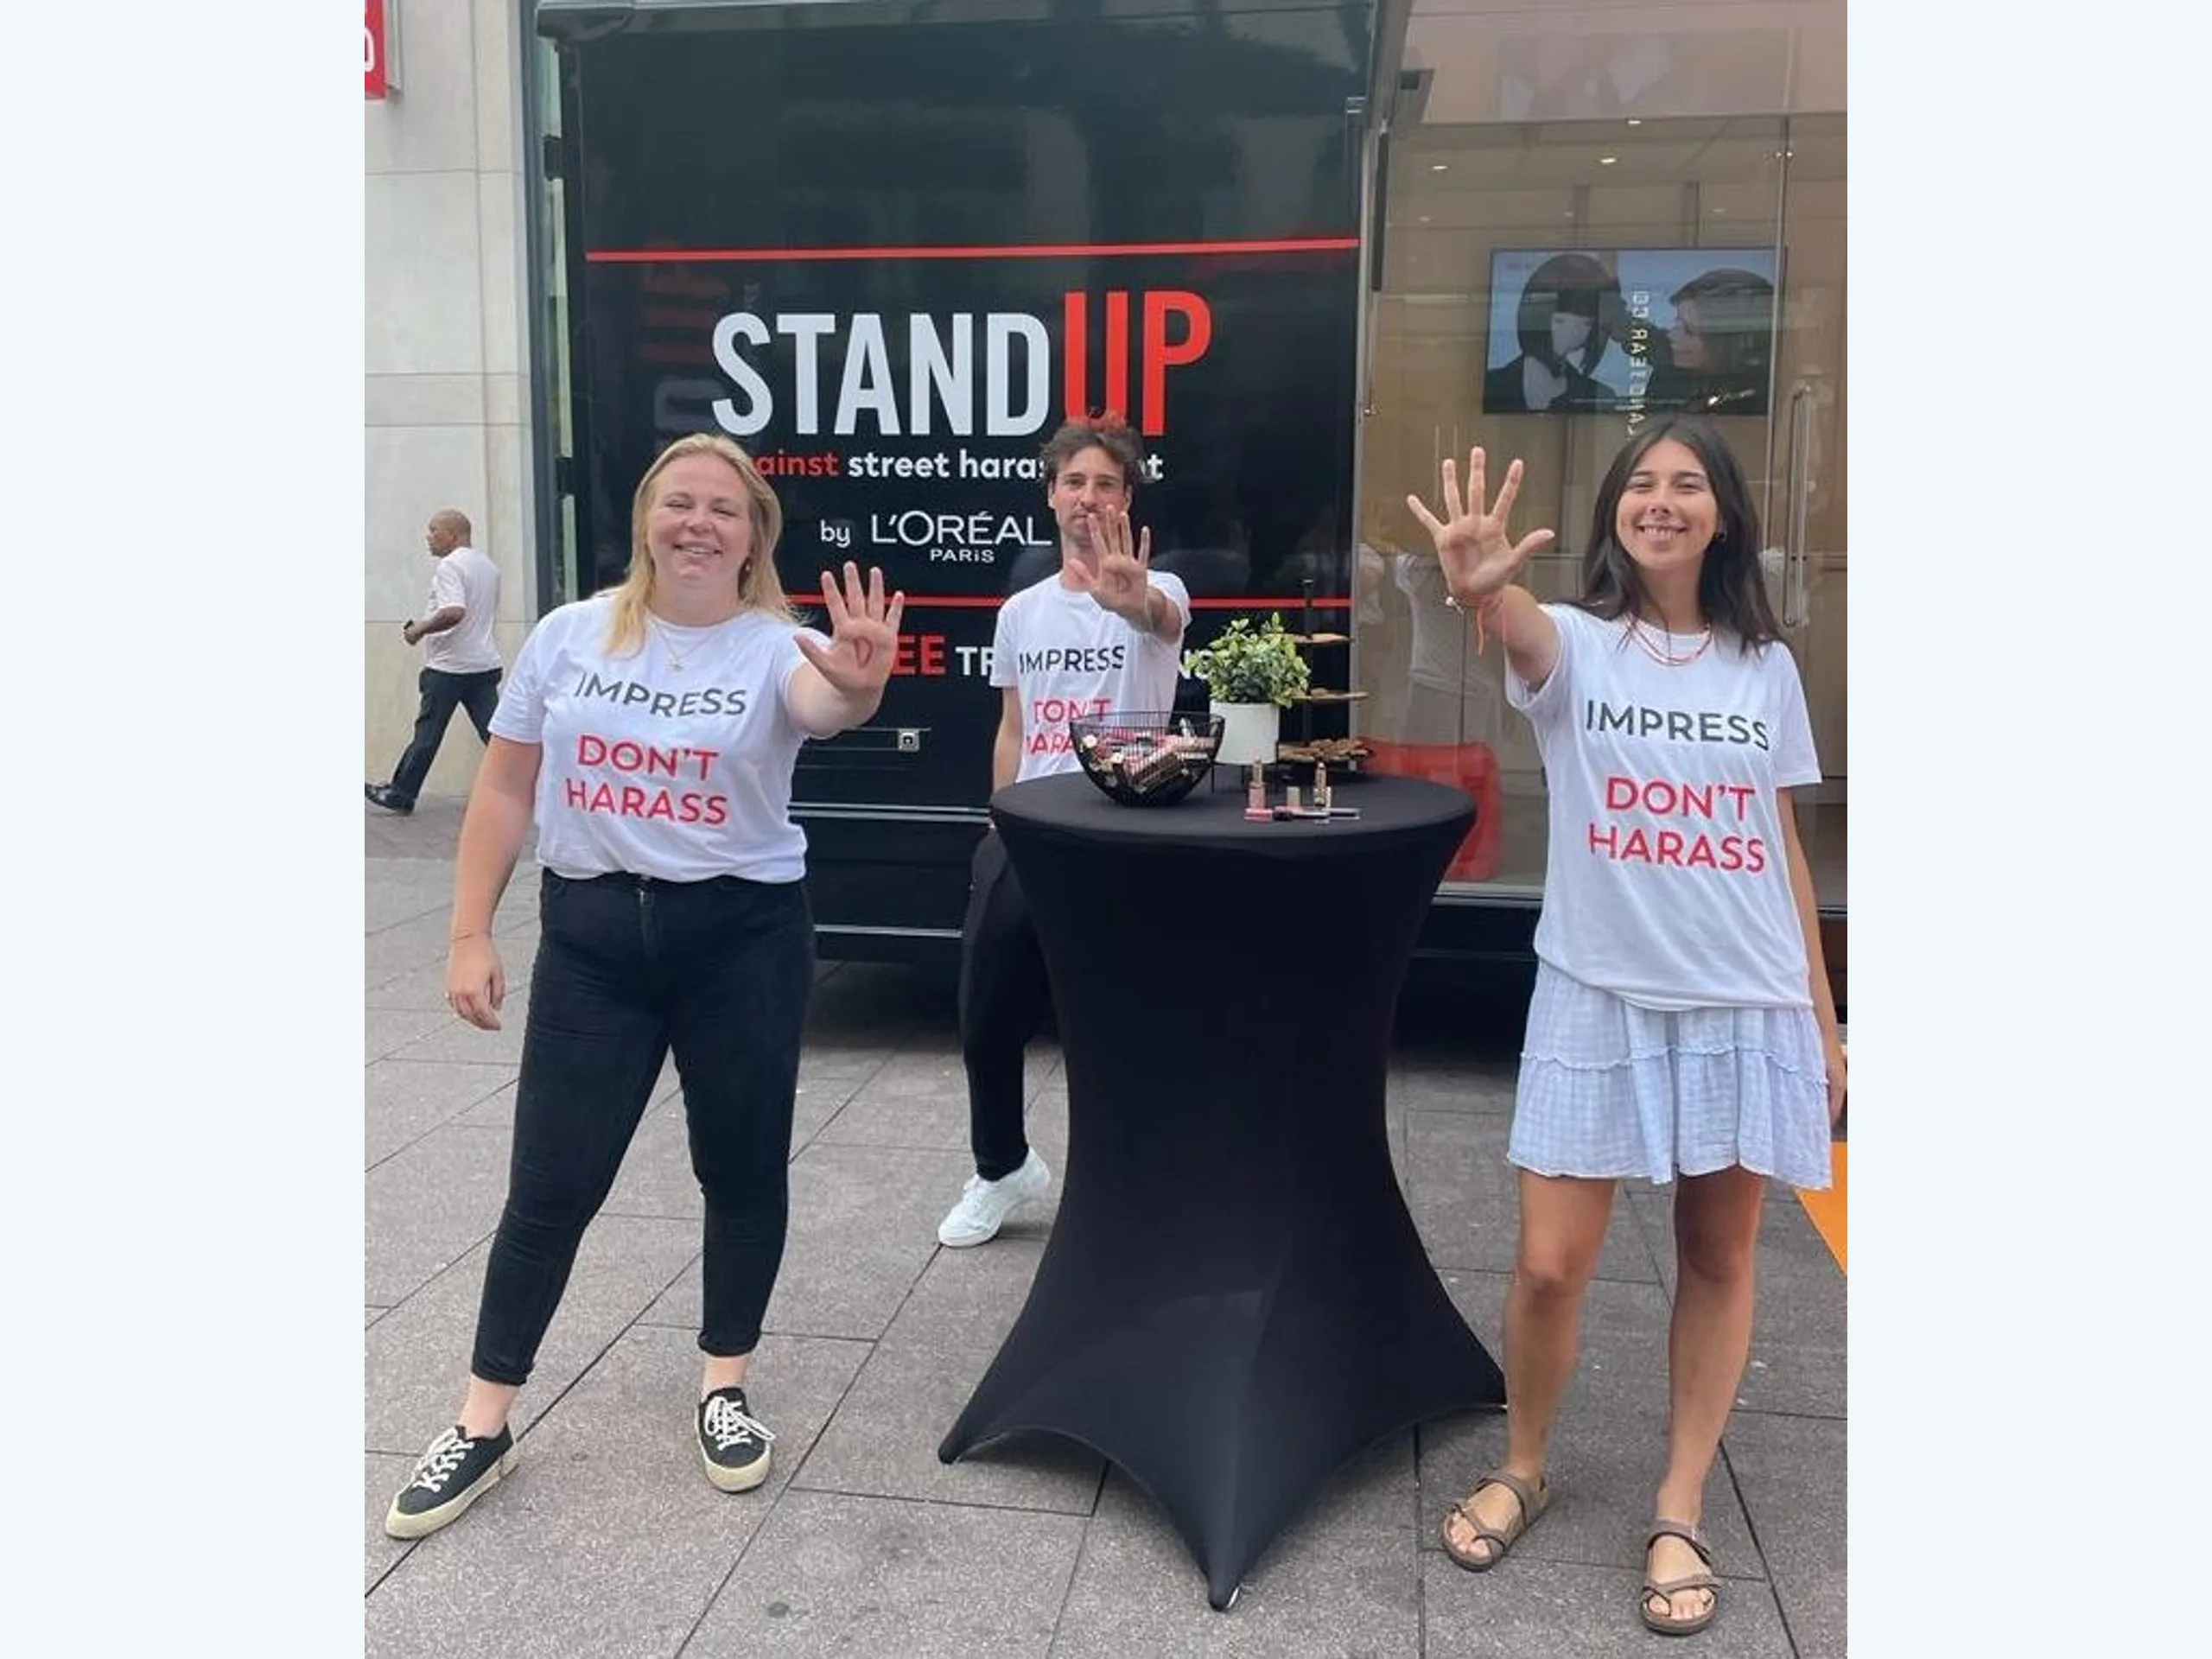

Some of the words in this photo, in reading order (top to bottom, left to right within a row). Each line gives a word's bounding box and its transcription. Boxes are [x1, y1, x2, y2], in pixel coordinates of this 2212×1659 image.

[750, 449, 839, 478] ainst
[849, 451, 950, 478] street
[820, 519, 851, 548] by
[892, 634, 947, 676] EE
[1019, 645, 1125, 673] IMPRESS
[571, 671, 747, 718] IMPRESS
[1585, 698, 1770, 752] IMPRESS
[576, 734, 719, 781] DON'T
[565, 778, 728, 826] HARASS
[1605, 776, 1755, 822] DON'T
[1587, 822, 1765, 874] HARASS
